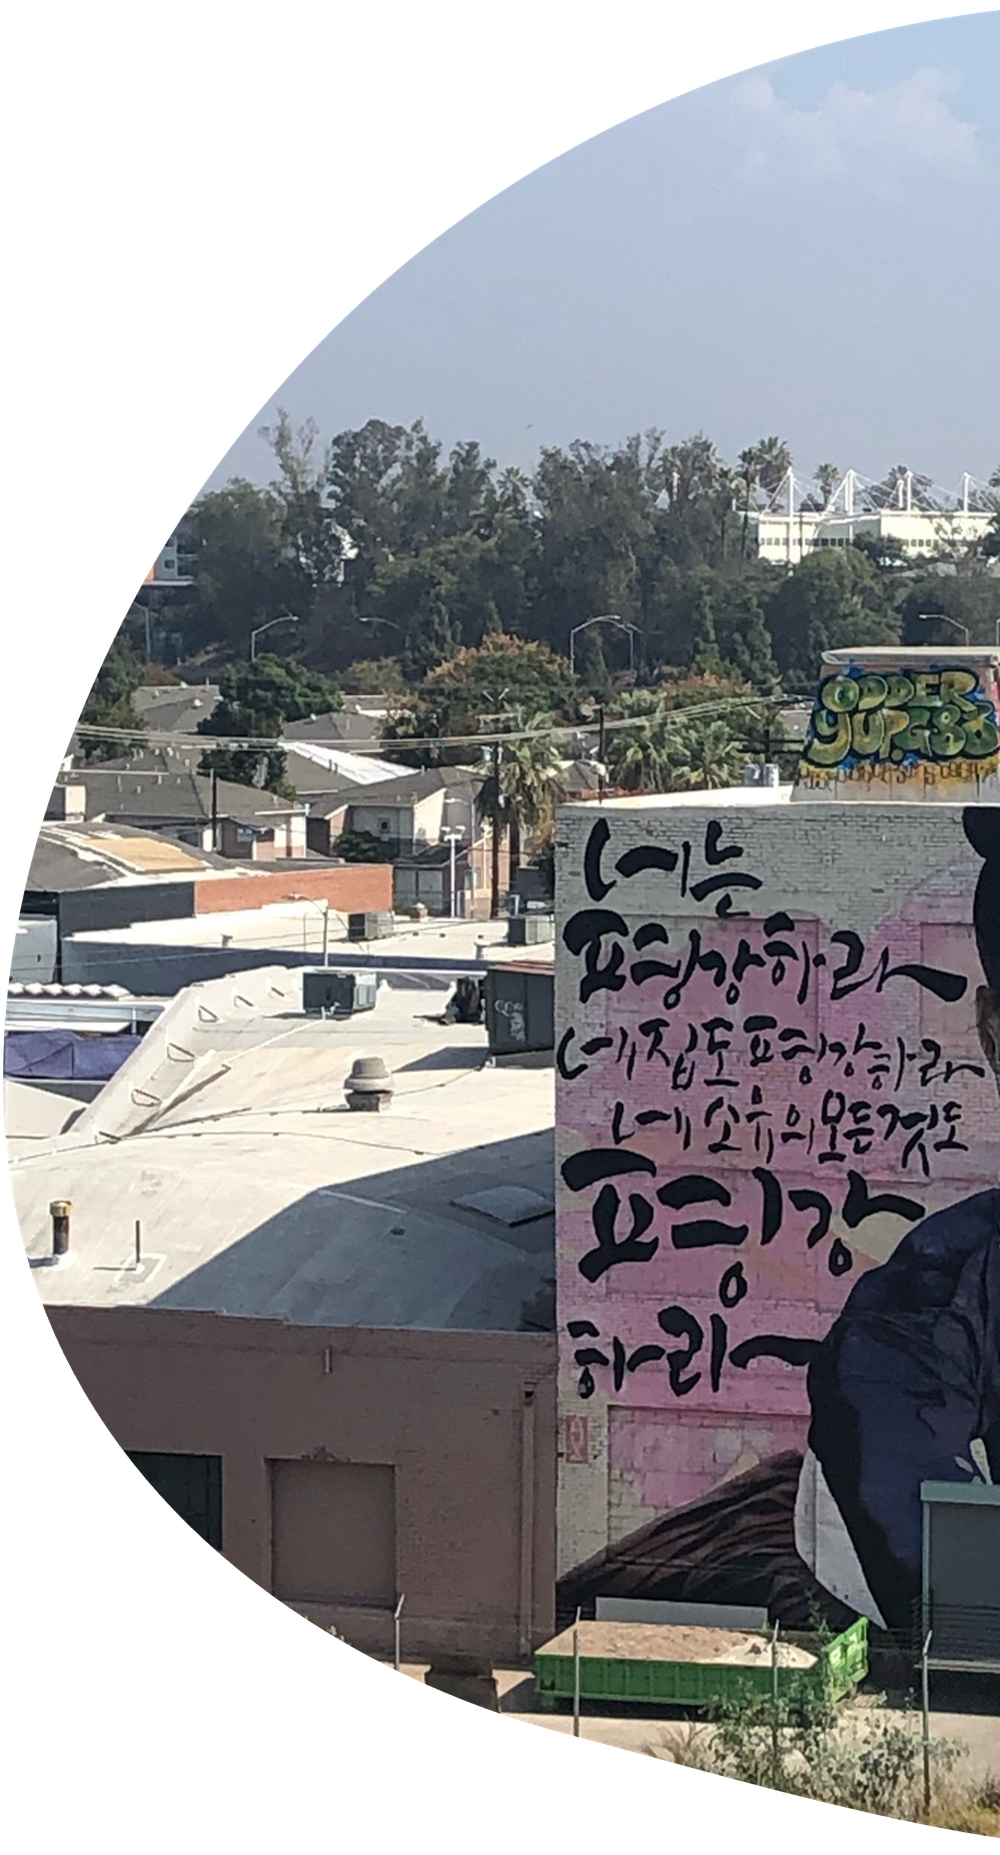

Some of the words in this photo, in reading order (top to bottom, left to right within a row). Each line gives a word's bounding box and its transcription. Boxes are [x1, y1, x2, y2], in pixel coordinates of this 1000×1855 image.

[584, 818, 763, 918] 너는
[562, 909, 969, 1010] 평강하라
[560, 1147, 926, 1309] 평강
